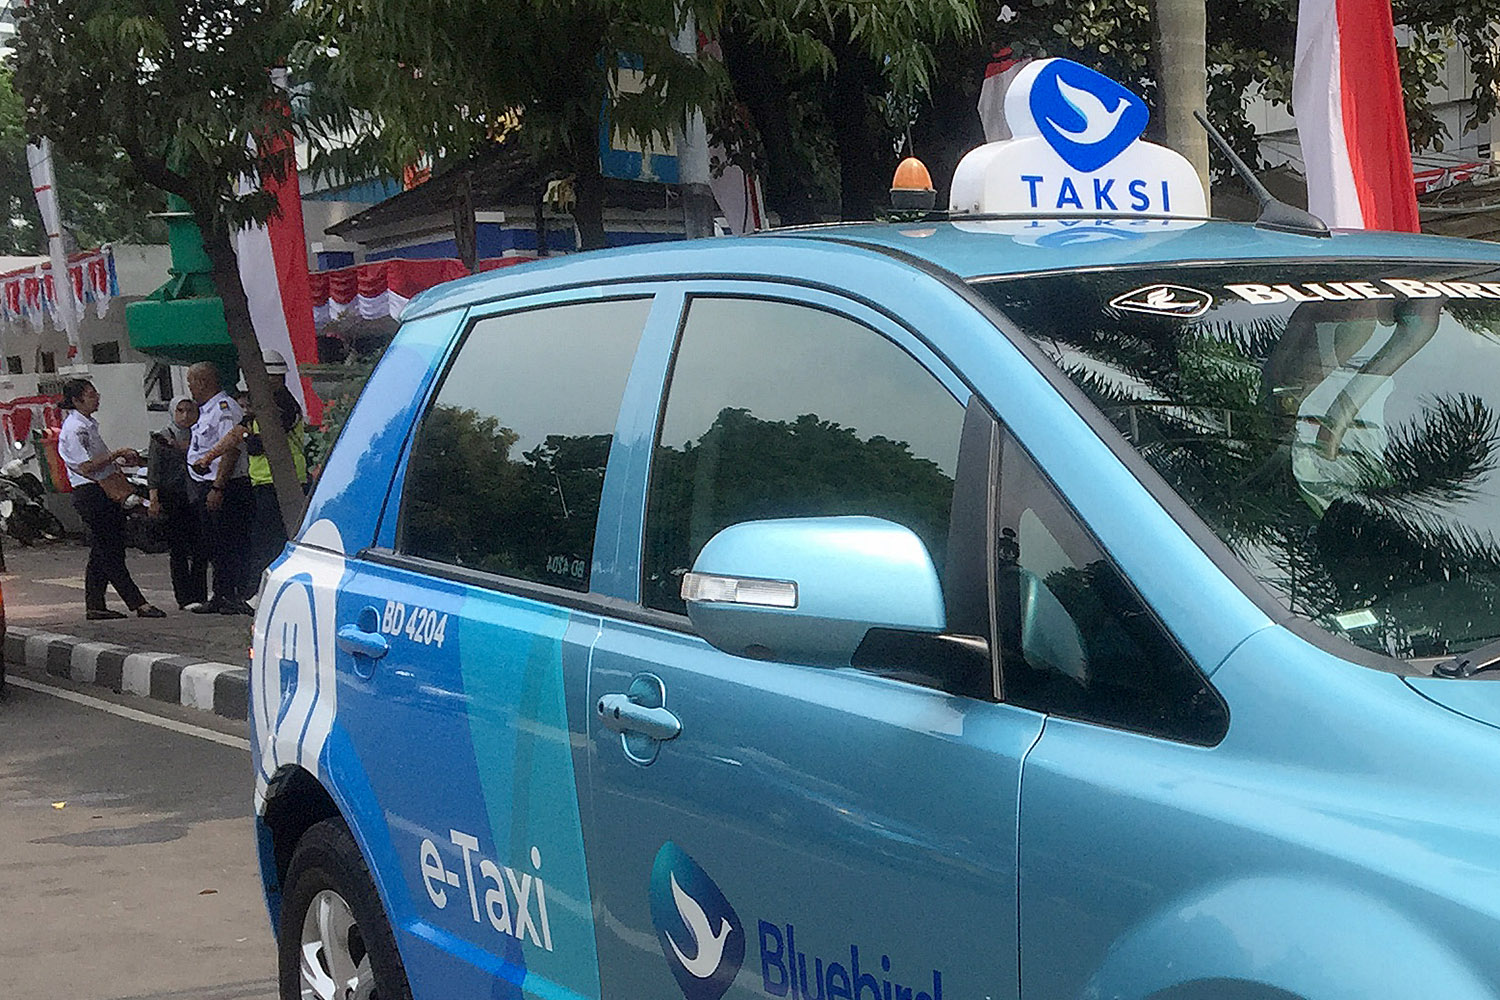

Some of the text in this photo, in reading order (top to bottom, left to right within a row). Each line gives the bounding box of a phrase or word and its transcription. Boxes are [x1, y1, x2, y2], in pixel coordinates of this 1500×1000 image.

[1021, 175, 1170, 212] TAKSI
[1223, 282, 1396, 305] BLUE
[382, 600, 448, 649] BD 4204
[420, 828, 553, 952] e-Taxi
